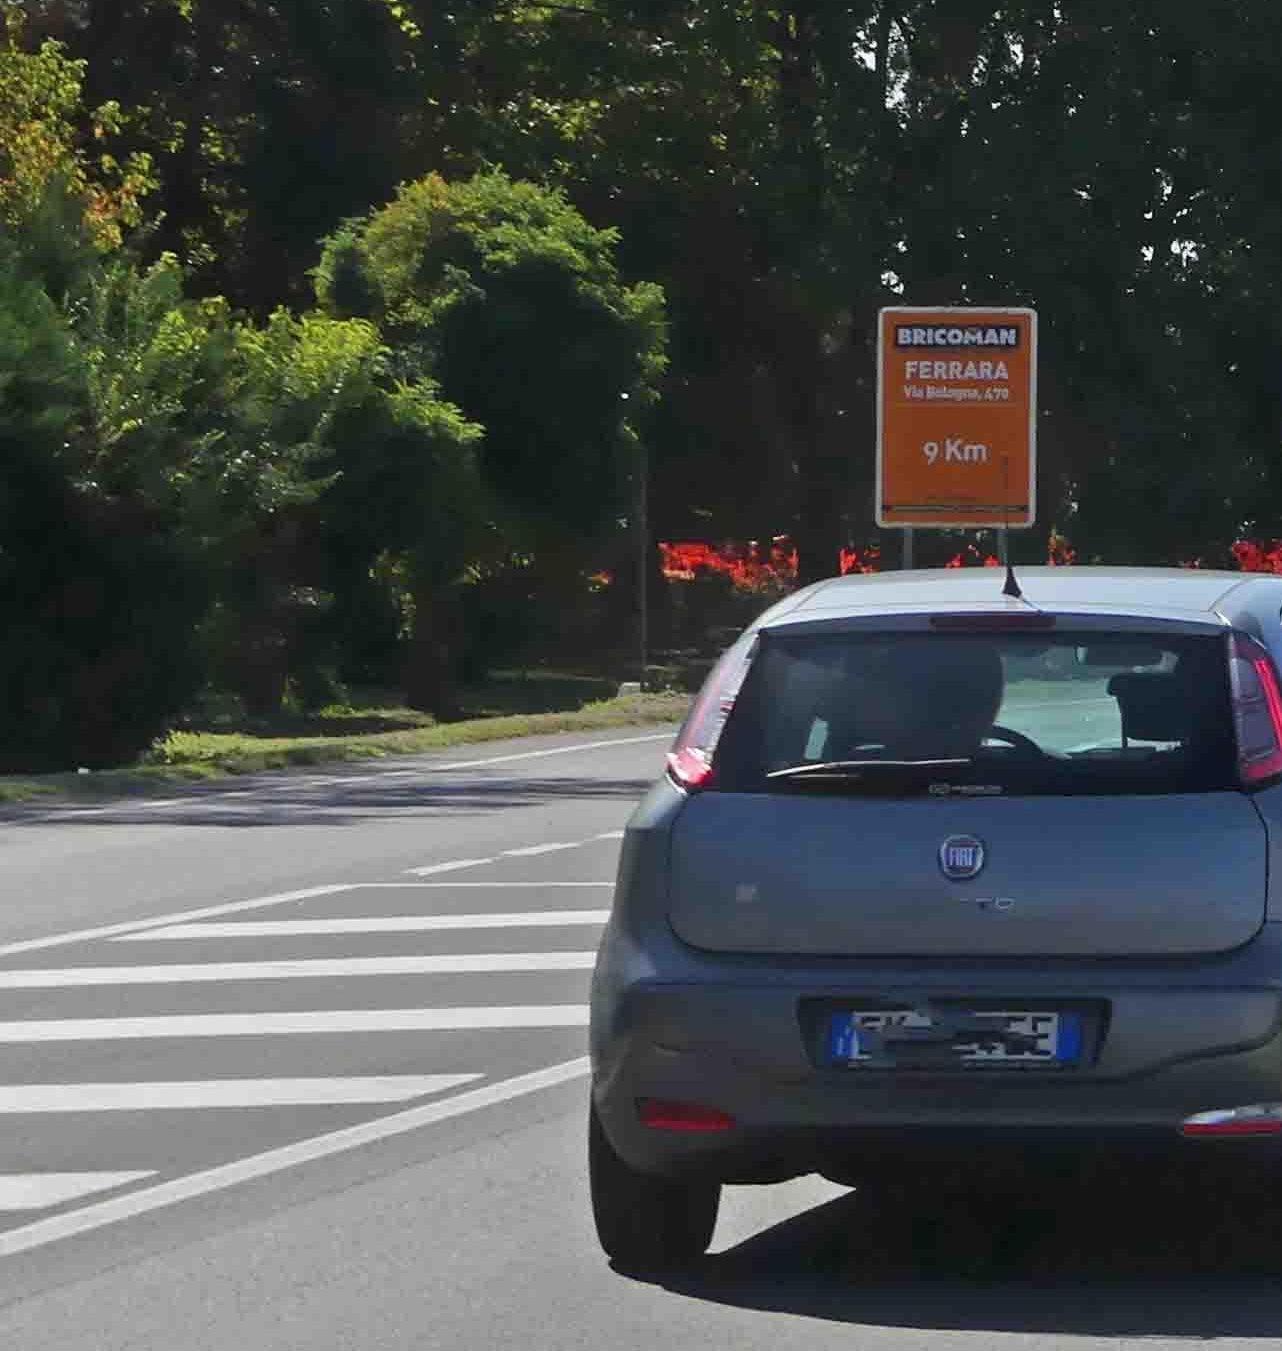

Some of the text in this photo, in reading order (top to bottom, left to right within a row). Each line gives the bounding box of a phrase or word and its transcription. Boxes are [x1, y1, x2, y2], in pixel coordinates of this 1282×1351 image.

[897, 328, 1017, 346] BRICOMAN
[904, 360, 1009, 380] FERRARA
[923, 439, 988, 464] 9 Km
[949, 846, 975, 866] FIAT
